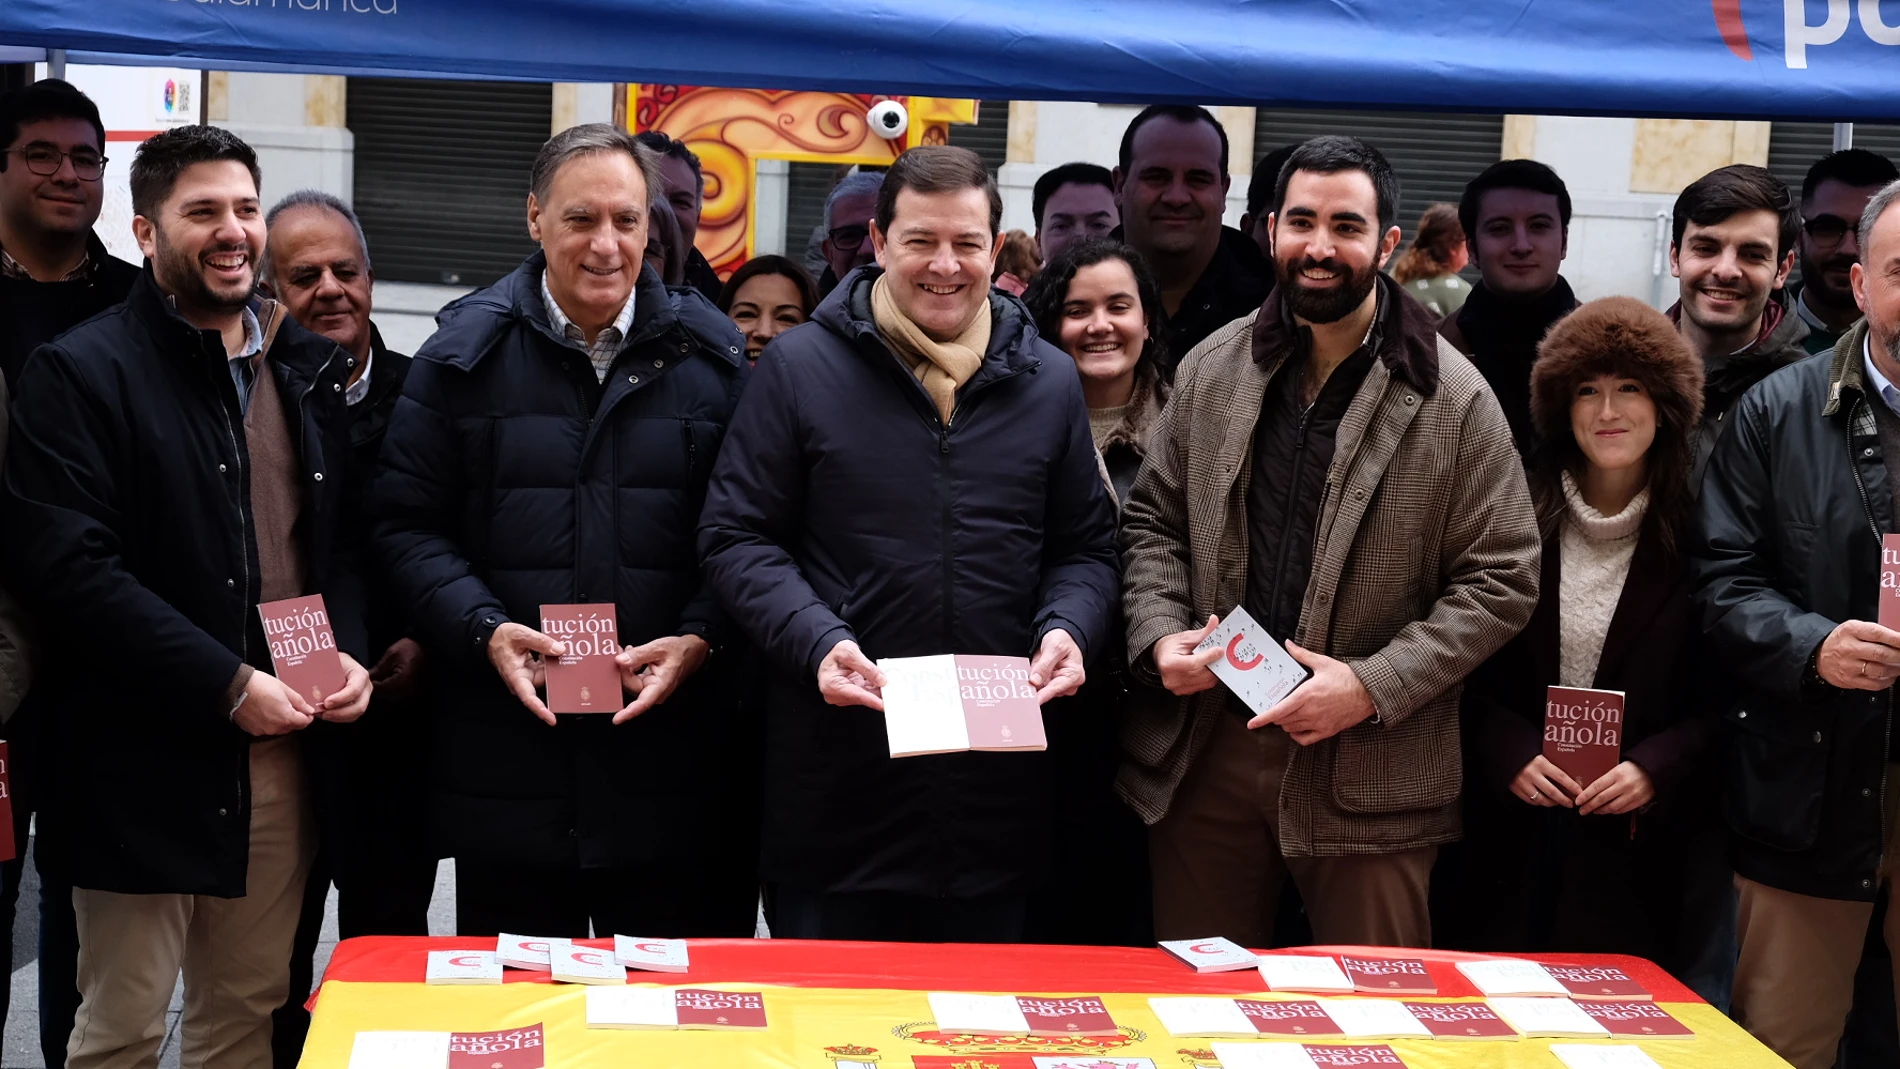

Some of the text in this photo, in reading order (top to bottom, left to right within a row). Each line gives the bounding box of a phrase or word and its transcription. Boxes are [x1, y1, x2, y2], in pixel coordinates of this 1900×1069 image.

[264, 606, 327, 635] tución
[542, 613, 614, 634] tución
[272, 627, 334, 659] añola
[556, 632, 617, 656] ñola
[957, 663, 1030, 681] tución
[961, 680, 1035, 700] añola
[1547, 700, 1620, 723] tución
[1544, 720, 1618, 747] añola
[1344, 958, 1423, 968] tución
[676, 992, 759, 1002] tución
[1018, 998, 1100, 1008] tución
[1237, 1002, 1320, 1011] tución
[1406, 1004, 1489, 1013] tución
[450, 1029, 541, 1044] tución
[450, 1038, 542, 1052] añola
[1305, 1047, 1394, 1056] tución
